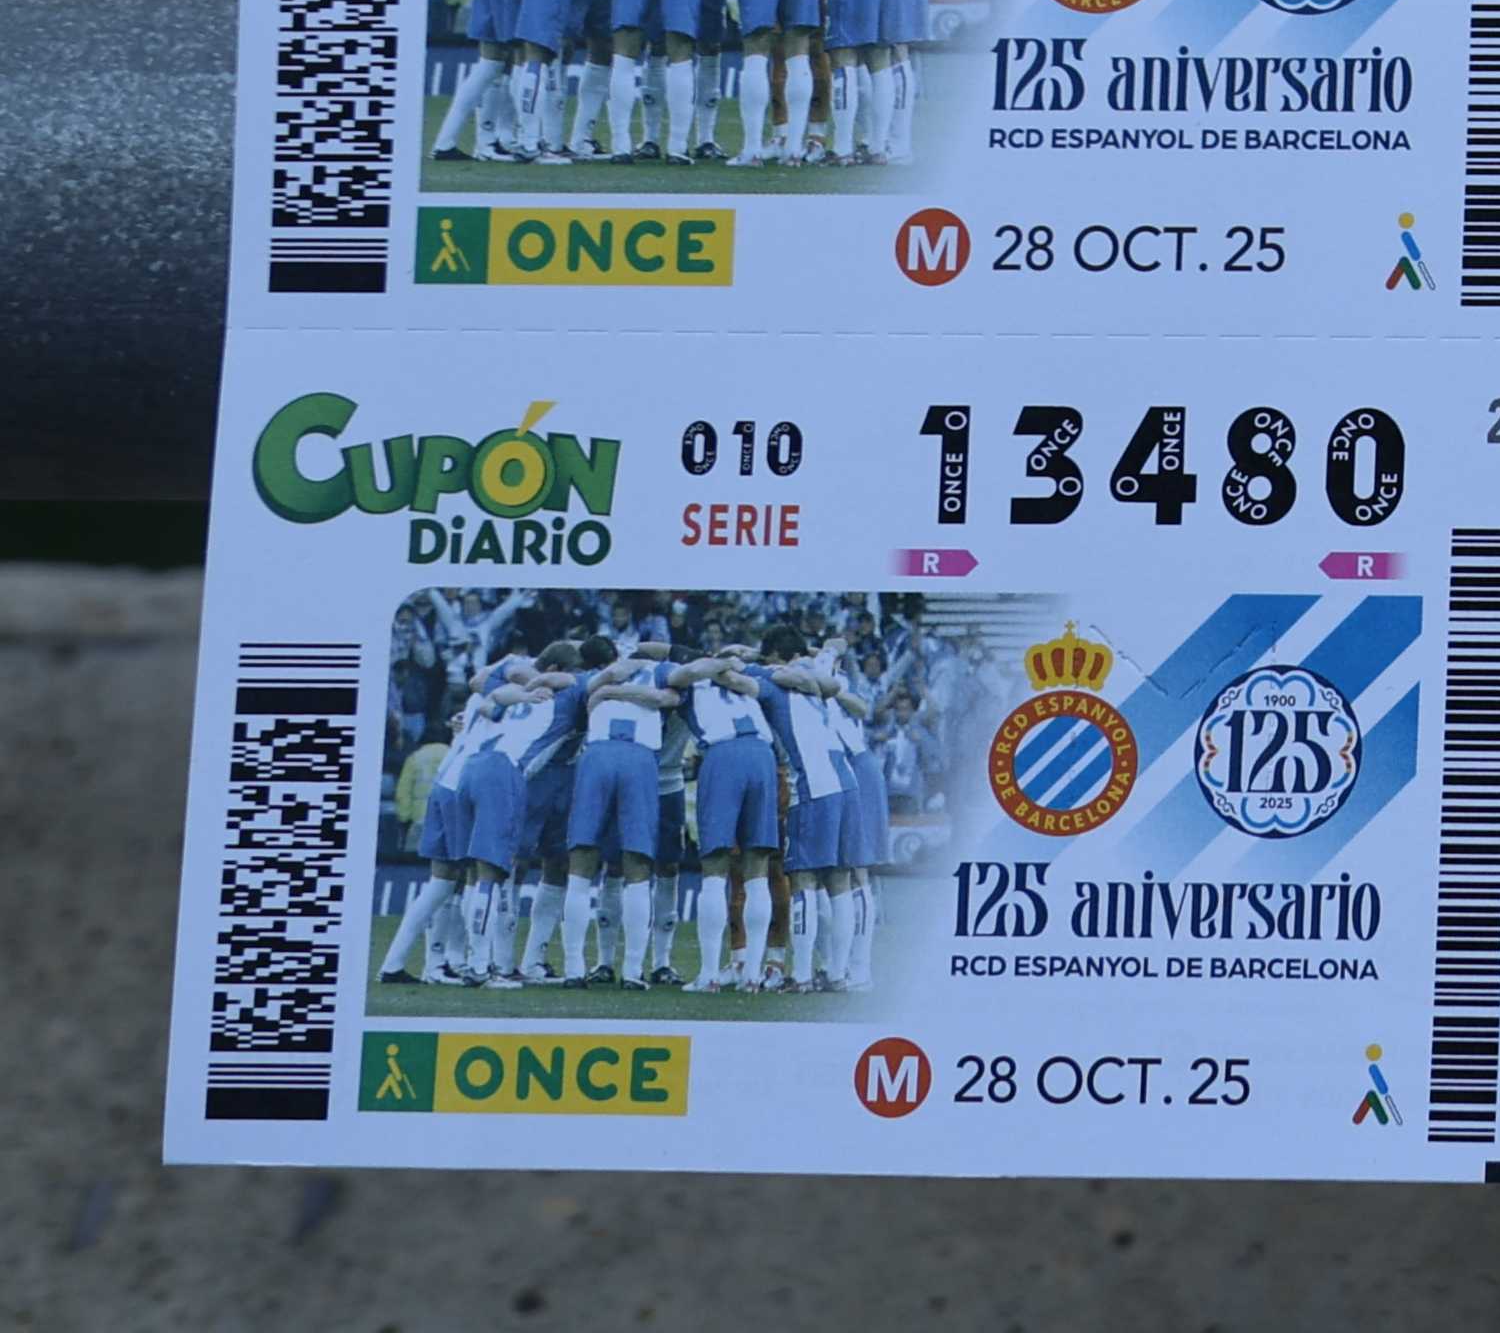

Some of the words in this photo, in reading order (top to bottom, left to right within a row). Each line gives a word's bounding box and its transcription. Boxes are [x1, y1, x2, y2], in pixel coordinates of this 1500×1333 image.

[991, 38, 1087, 111] 125
[1107, 45, 1412, 113] aniversario
[989, 128, 1044, 149] RCD
[1051, 128, 1194, 150] ESPANYOL
[1201, 129, 1238, 150] DE
[1244, 129, 1411, 150] BARCELONA
[503, 215, 718, 277] ONCE
[907, 225, 959, 271] M
[992, 224, 1054, 272] 28
[1073, 225, 1208, 273] OCT.
[1223, 226, 1285, 273] 25
[681, 420, 803, 477] 010
[919, 405, 1406, 527] 13480
[681, 503, 801, 548] SERIE
[953, 862, 1051, 938] 125
[1071, 870, 1381, 941] aniversario
[951, 955, 1007, 976] RCD
[1014, 955, 1159, 978] ESPANYOL
[1166, 957, 1203, 978] DE
[1210, 957, 1379, 980] BARCELONA
[450, 1043, 673, 1106] ONCE
[866, 1055, 919, 1103] M
[954, 1055, 1017, 1104] 28
[1036, 1056, 1172, 1105] OCT.
[1188, 1057, 1250, 1106] 25
